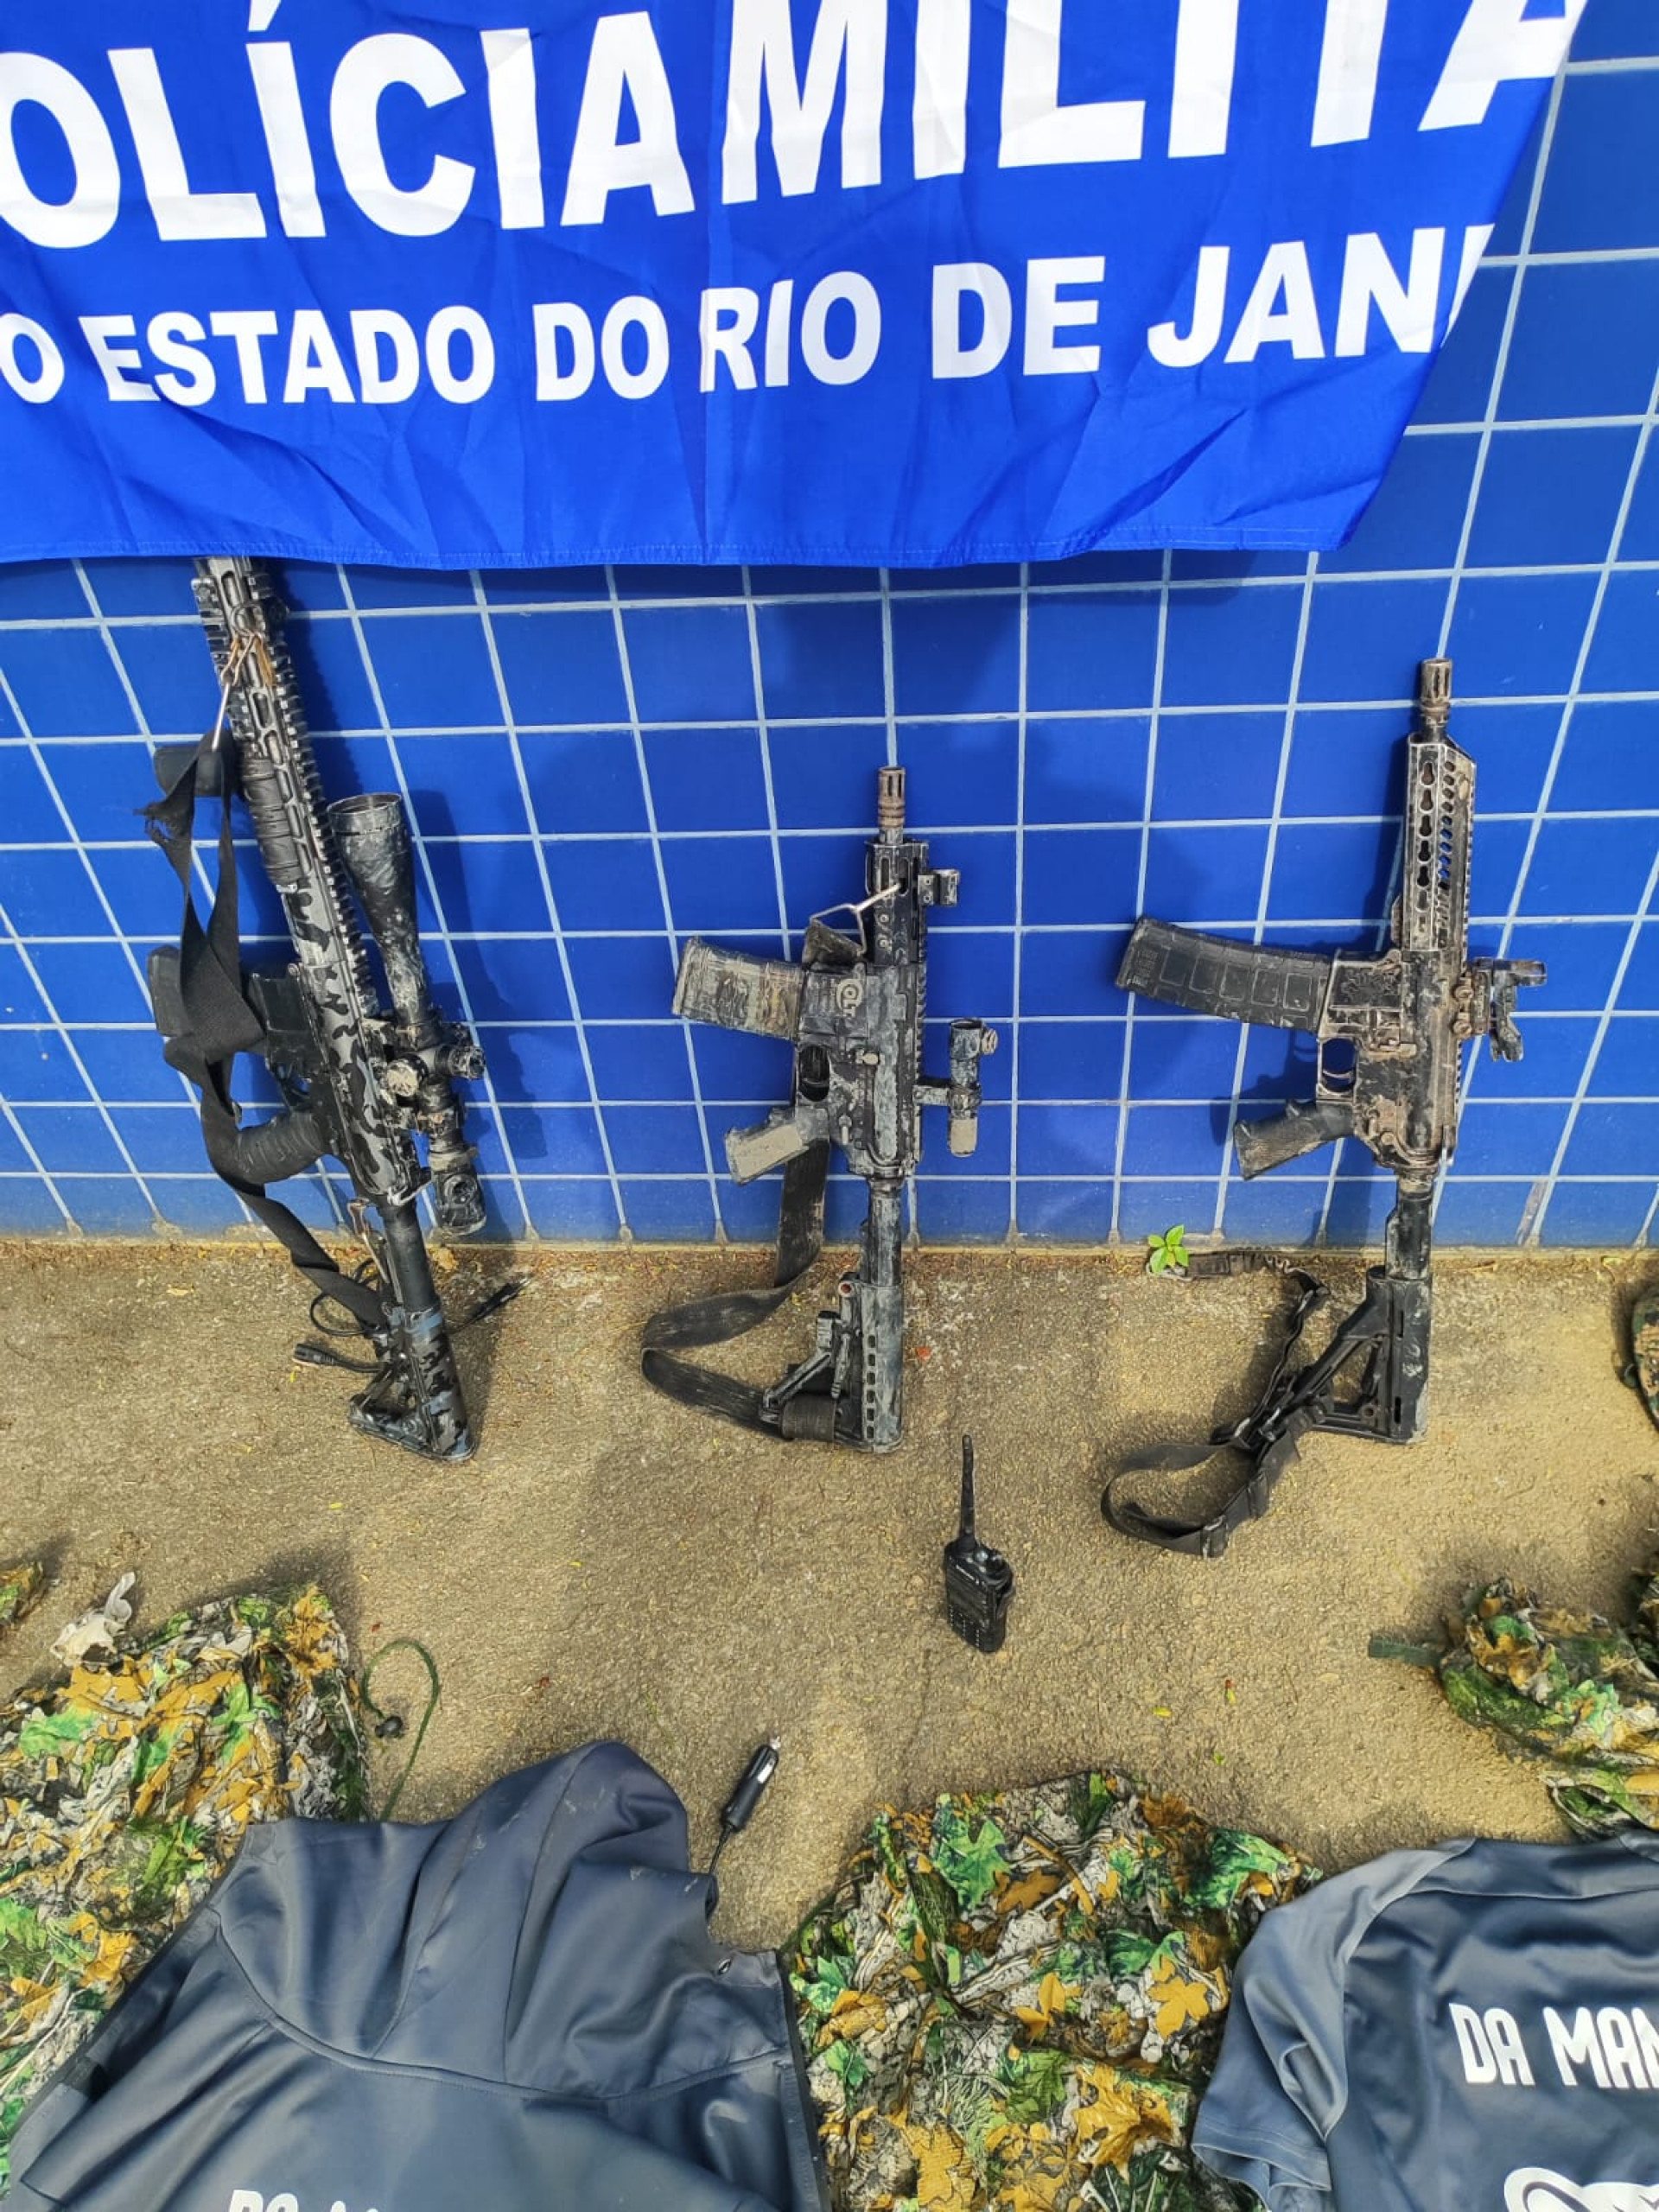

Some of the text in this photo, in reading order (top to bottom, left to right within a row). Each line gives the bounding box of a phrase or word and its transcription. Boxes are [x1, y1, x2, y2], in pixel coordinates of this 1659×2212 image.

[79, 305, 495, 405] ESTADO
[532, 296, 670, 402] DO
[699, 271, 881, 393] RIO
[932, 256, 1105, 378] DE
[1147, 223, 1495, 367] JAN
[1448, 2003, 1535, 2086] DA
